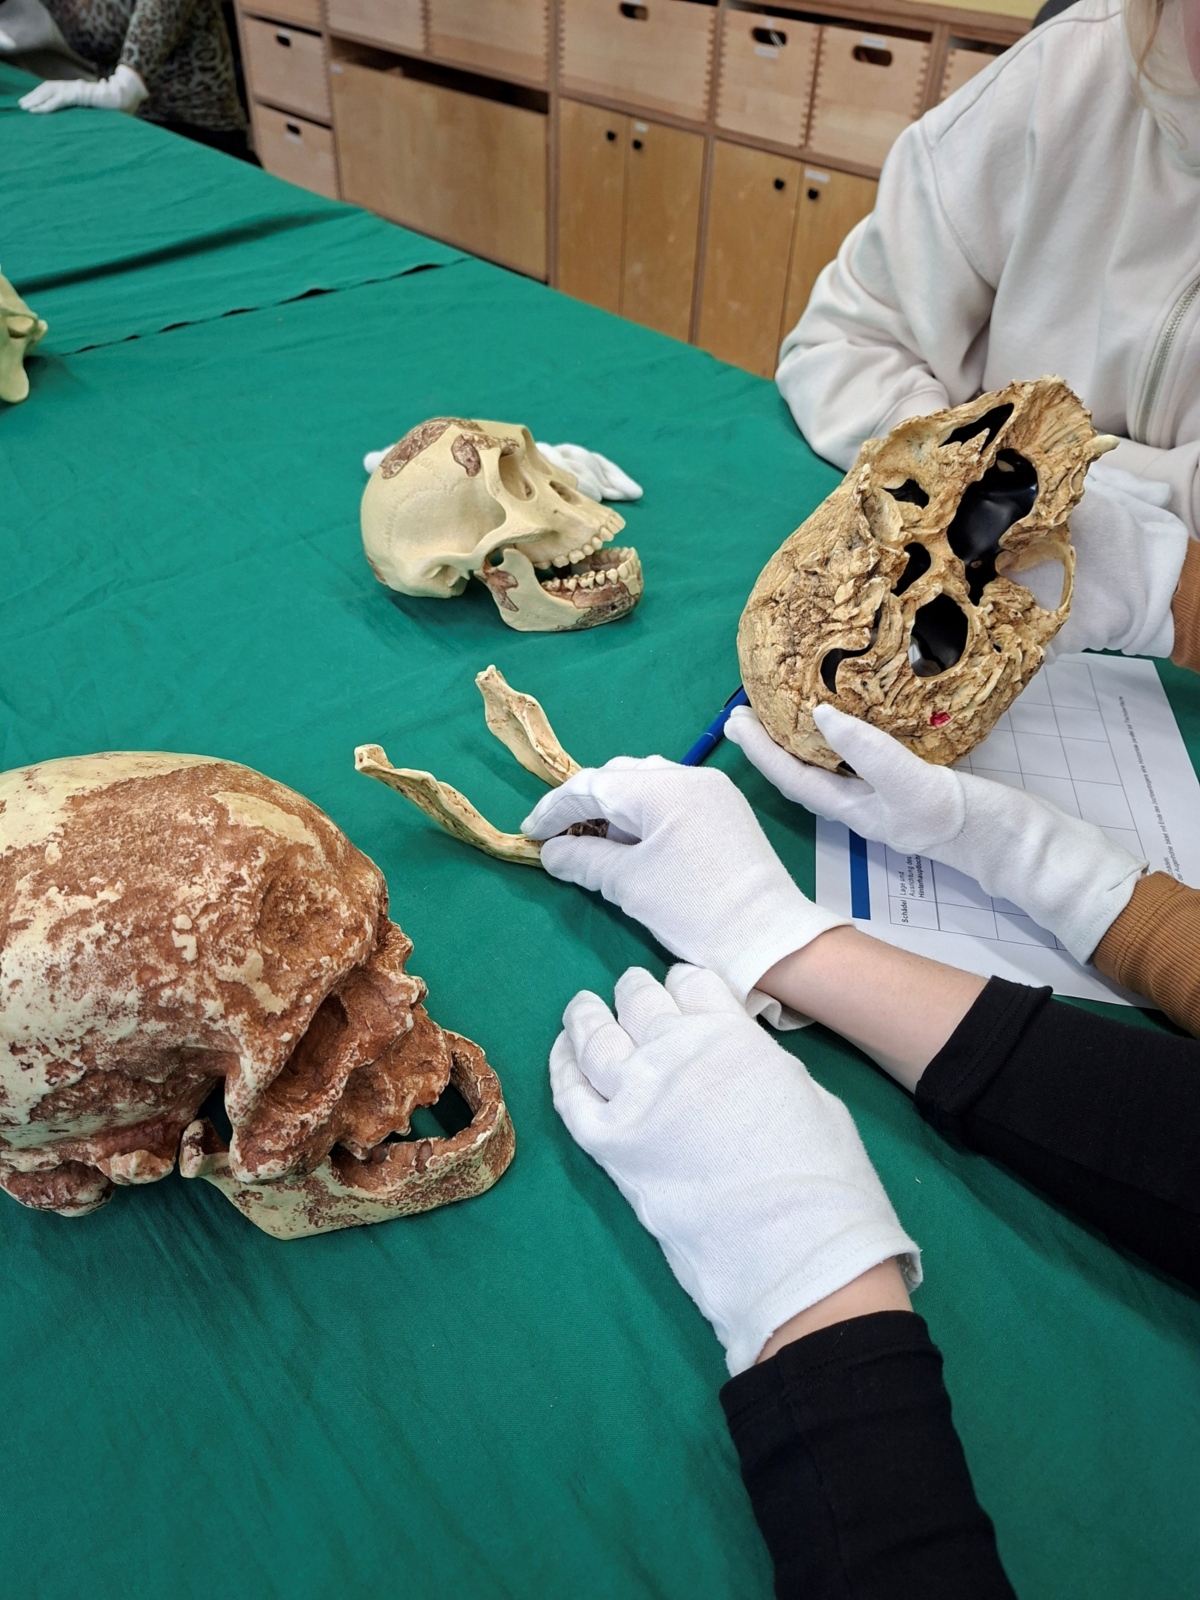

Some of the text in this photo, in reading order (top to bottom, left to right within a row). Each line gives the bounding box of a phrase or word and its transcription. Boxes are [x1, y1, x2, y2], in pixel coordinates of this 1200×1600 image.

[915, 854, 925, 898] Hinterhauptloch
[1164, 856, 1173, 876] chädels
[907, 866, 915, 897] Ausrichtung
[900, 900, 909, 923] Schädel
